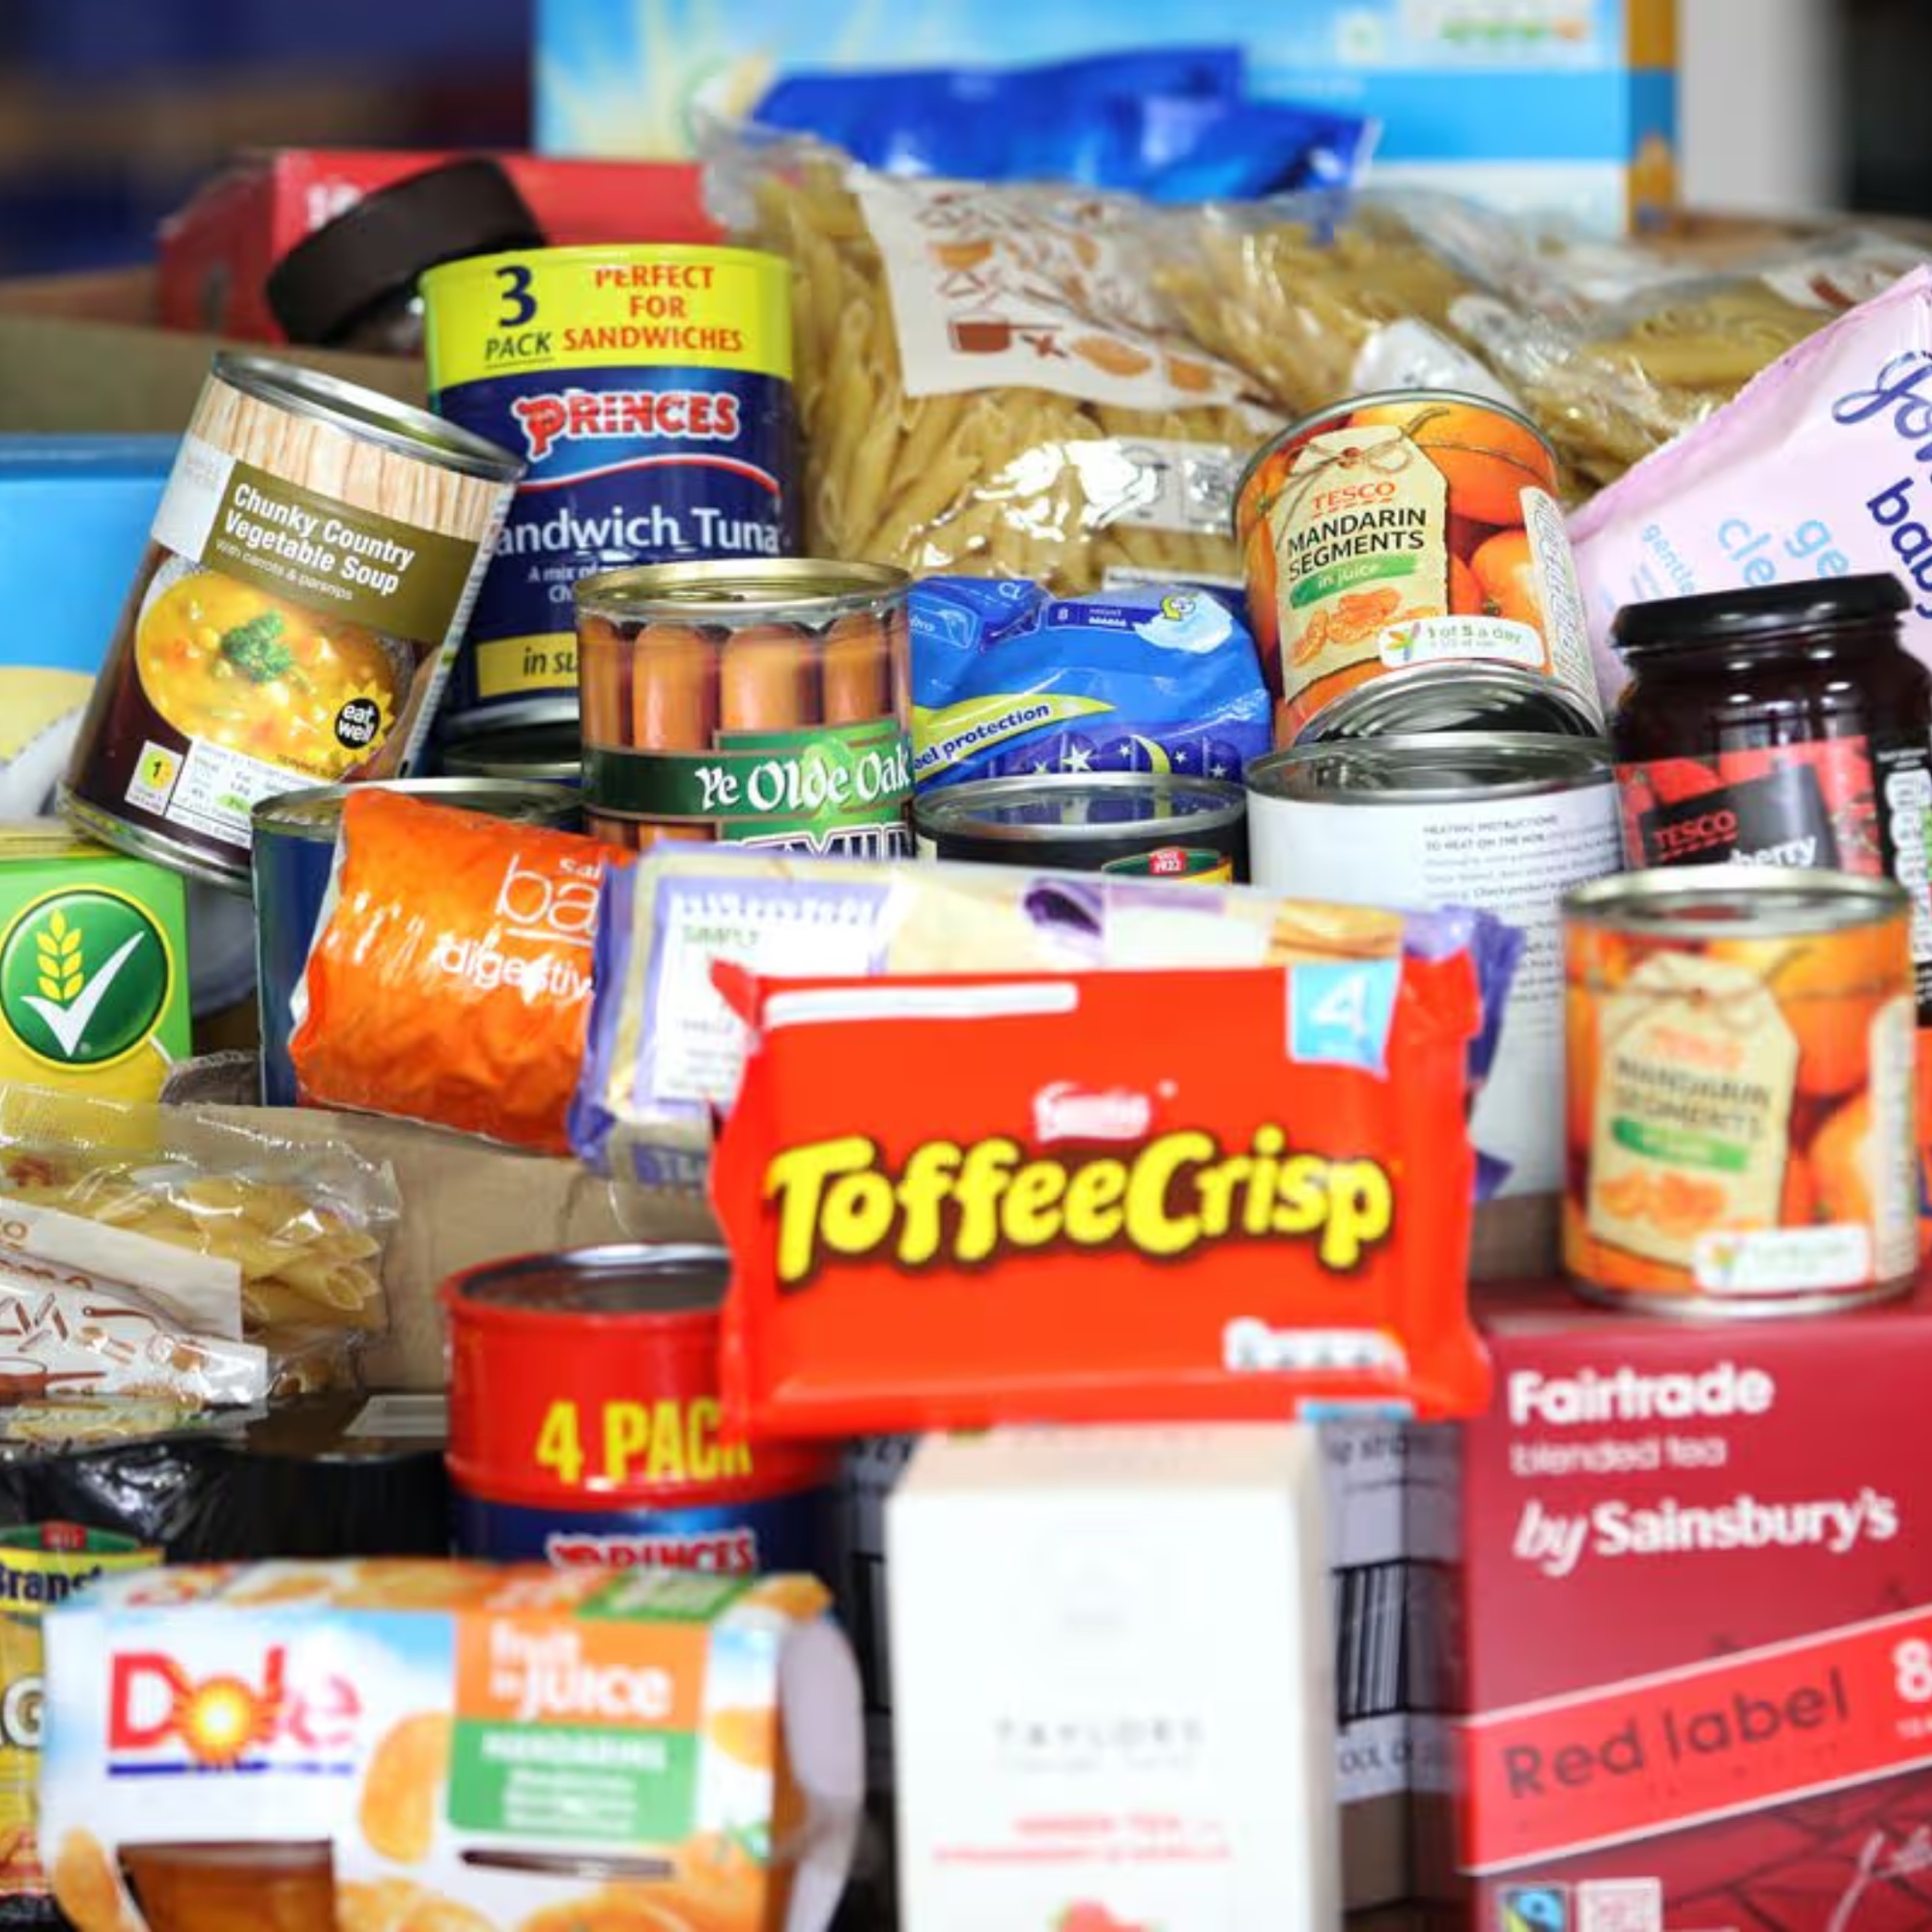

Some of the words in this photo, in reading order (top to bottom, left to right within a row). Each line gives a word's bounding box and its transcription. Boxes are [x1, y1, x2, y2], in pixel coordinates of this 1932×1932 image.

[496, 265, 537, 327] 3
[596, 265, 716, 289] PERFECT
[630, 295, 687, 318] FOR
[485, 331, 553, 361] PACK
[563, 326, 744, 352] SANDWICHES
[512, 390, 738, 460] PRINCES
[1312, 481, 1397, 512] TESCO
[226, 510, 335, 572] Vegetable
[341, 555, 399, 596] Soup
[235, 483, 319, 537] Chunky
[323, 520, 415, 572] Country
[495, 505, 678, 555] andwich
[691, 506, 780, 554] Tuna
[1288, 508, 1427, 558] MANDARIN
[1718, 519, 1776, 586] cle
[1783, 520, 1850, 578] ge
[528, 567, 541, 582] A
[543, 565, 574, 582] mix
[1289, 530, 1426, 582] SEGMENTS
[1318, 573, 1333, 589] in
[524, 646, 548, 675] in
[338, 719, 374, 743] well
[344, 703, 375, 724] eat
[944, 702, 1051, 762] protection
[695, 766, 740, 811] Ye
[747, 758, 850, 812] Olde
[856, 743, 912, 802] Oak
[1655, 810, 1737, 852] TESCO
[1729, 836, 1818, 867] berry
[496, 853, 599, 934] ba
[438, 929, 595, 1002] digestiv
[1308, 973, 1367, 1040] 4
[1508, 1359, 1776, 1426] Fairtrade
[536, 1400, 583, 1485] 4
[1509, 1436, 1660, 1475] blended
[1664, 1435, 1728, 1467] tea
[1513, 1498, 1589, 1577] by
[1592, 1484, 1900, 1554] Sainsbury's
[106, 1643, 363, 1764] Dole
[1503, 1715, 1646, 1800] Red
[1662, 1665, 1850, 1766] label
